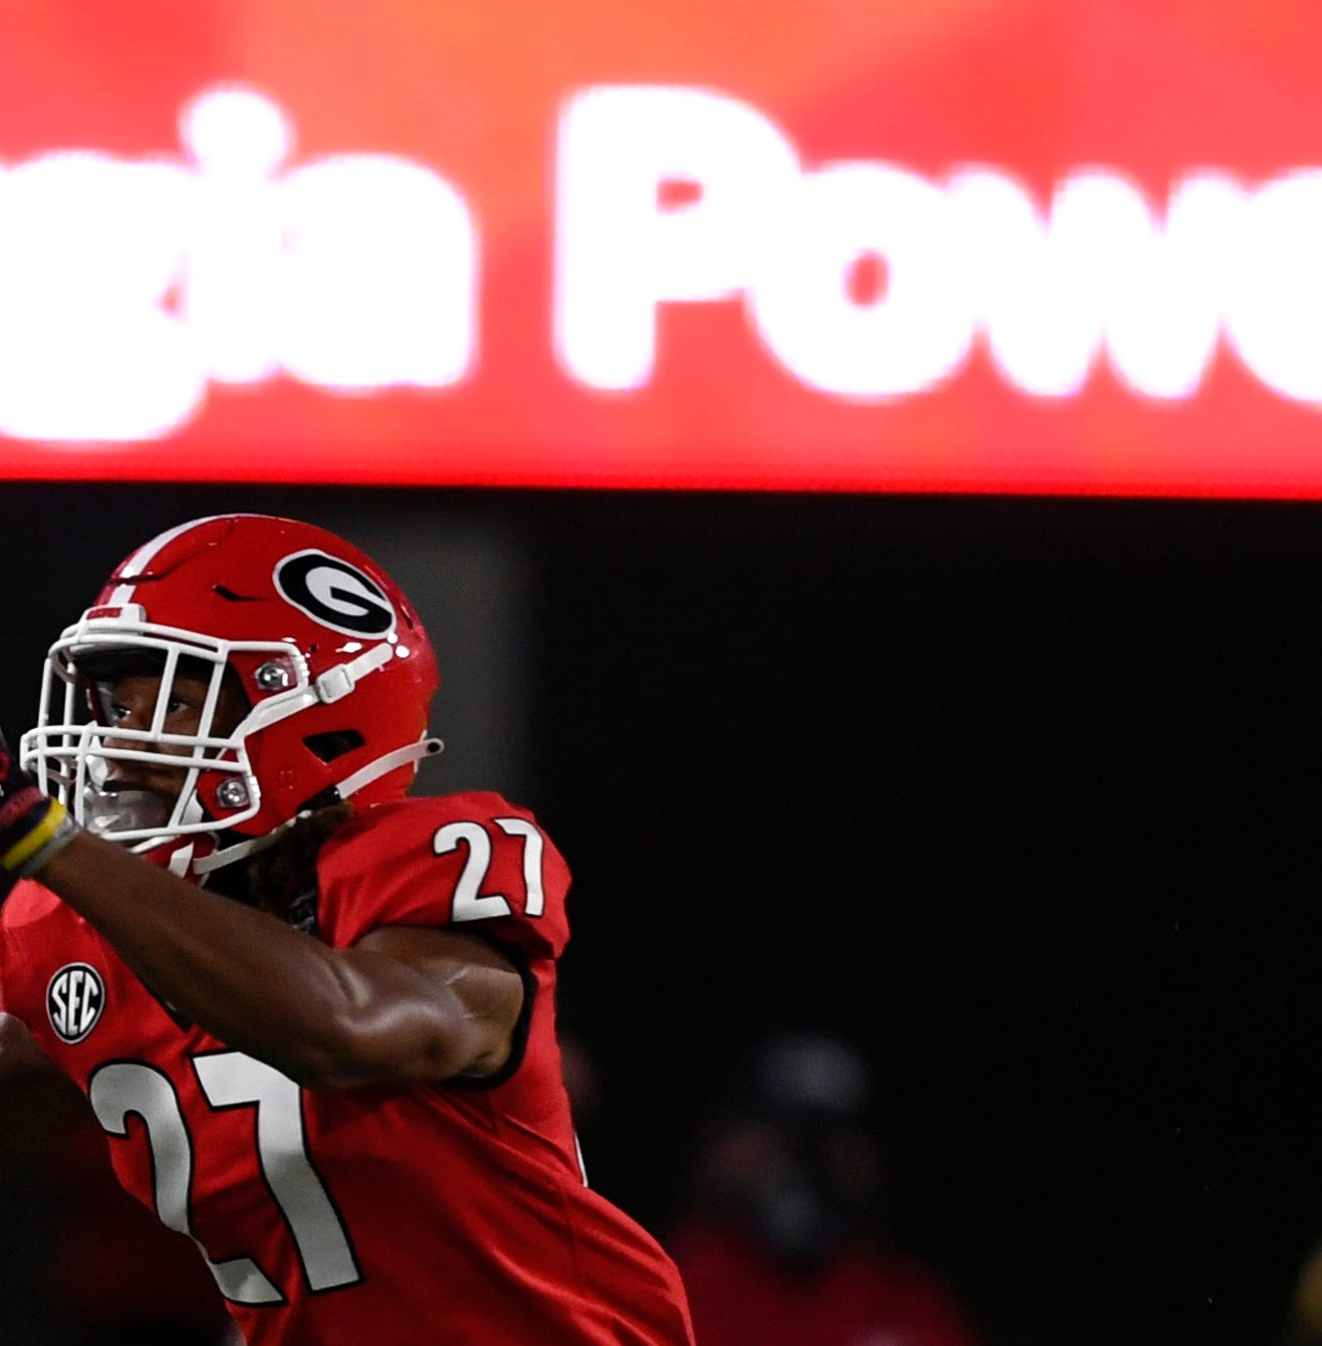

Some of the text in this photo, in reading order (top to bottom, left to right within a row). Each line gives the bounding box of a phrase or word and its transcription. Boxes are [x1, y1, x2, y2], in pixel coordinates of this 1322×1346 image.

[272, 549, 396, 639] G
[432, 816, 545, 923] 27
[49, 966, 102, 1038] SEC
[88, 1050, 365, 1307] 27
